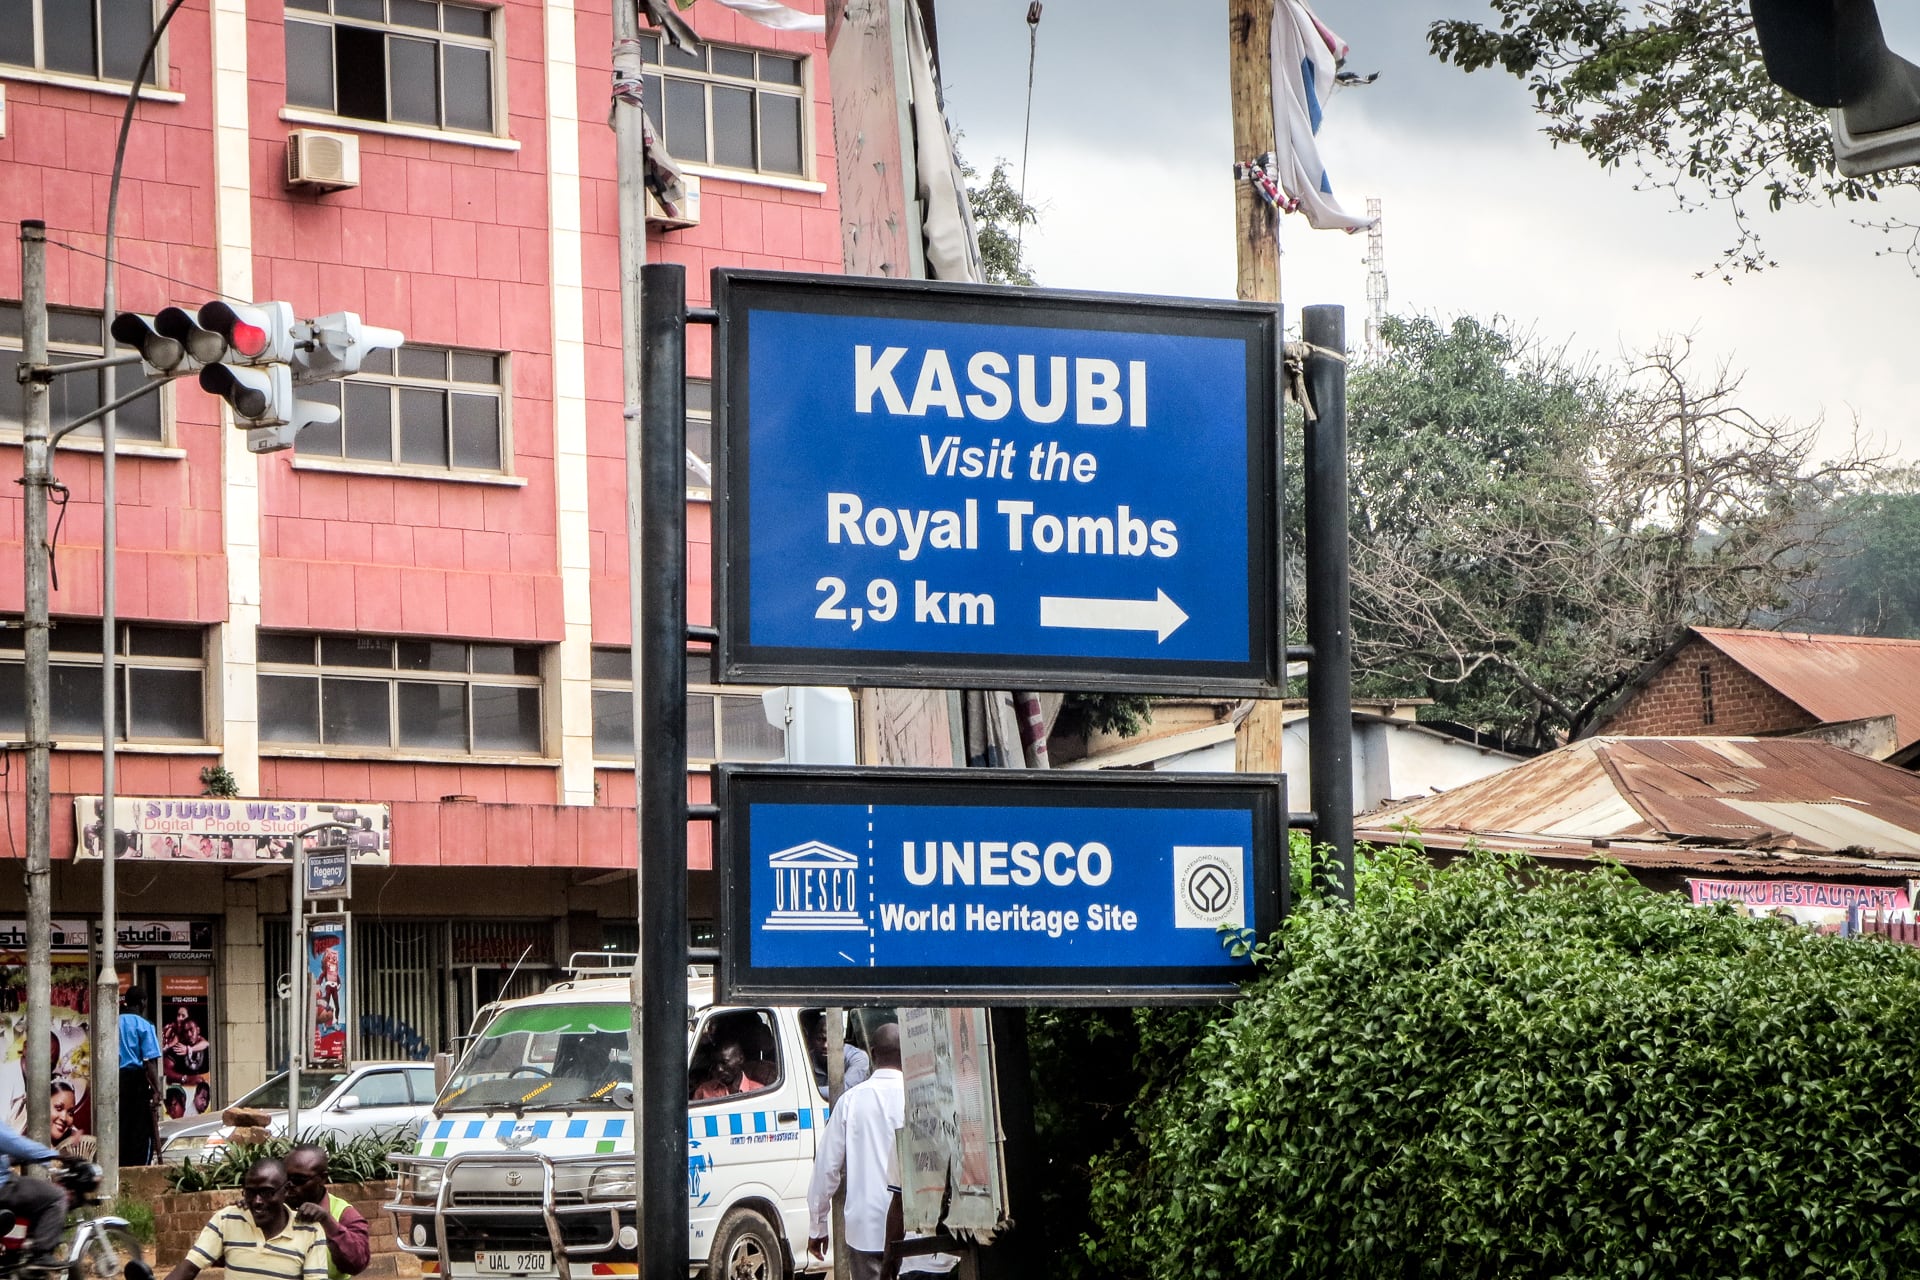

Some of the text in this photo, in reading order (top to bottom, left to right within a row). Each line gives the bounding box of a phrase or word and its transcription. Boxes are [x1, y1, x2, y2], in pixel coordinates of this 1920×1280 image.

[853, 344, 1147, 427] KASUBI
[919, 434, 1098, 484] Visit the
[826, 491, 1179, 561] Royal Tombs
[814, 575, 995, 632] 2,9 km
[144, 818, 194, 833] Digital
[205, 818, 250, 832] Photo
[246, 802, 309, 820] WEST
[313, 866, 343, 879] Regency
[903, 841, 1113, 887] UNESCO
[775, 869, 856, 911] UNESCO
[1772, 884, 1896, 908] RESTAURANT
[879, 903, 1138, 938] World Heritage Site
[167, 952, 211, 960] VIDEOGRAPHY
[489, 1254, 545, 1270] UAL 920Q
